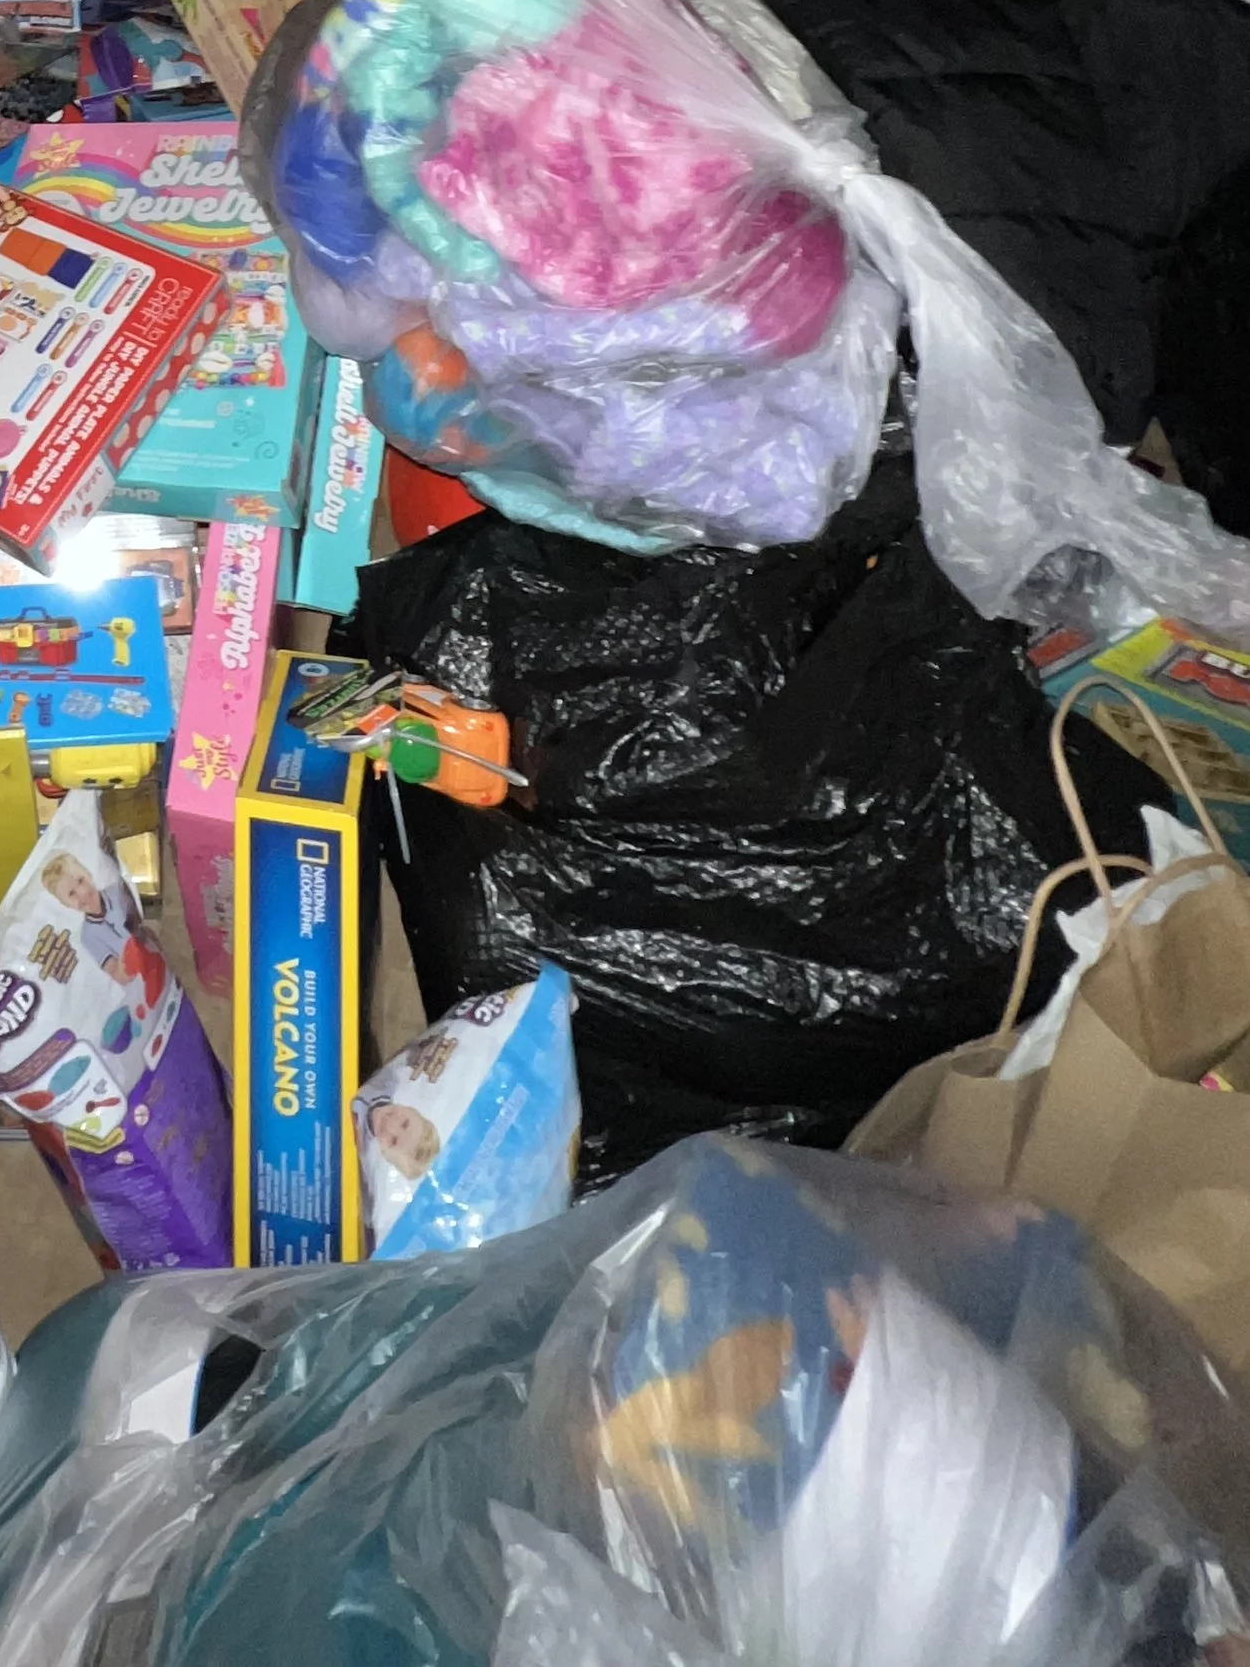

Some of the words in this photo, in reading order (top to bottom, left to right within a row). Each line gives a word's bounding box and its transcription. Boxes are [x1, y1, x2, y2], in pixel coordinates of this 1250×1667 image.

[84, 358, 121, 407] JUNGLE
[101, 363, 135, 407] PAPER
[53, 401, 90, 450] ANIMAL
[75, 401, 108, 443] PLATE
[38, 437, 82, 496] ANIMALS
[300, 863, 313, 939] GEOGRAPHIC
[312, 865, 327, 925] NATIONAL
[304, 969, 316, 1013] BUILD
[273, 958, 300, 1117] VOLCANO
[304, 1019, 317, 1064] YOUR
[304, 1069, 317, 1110] OWN
